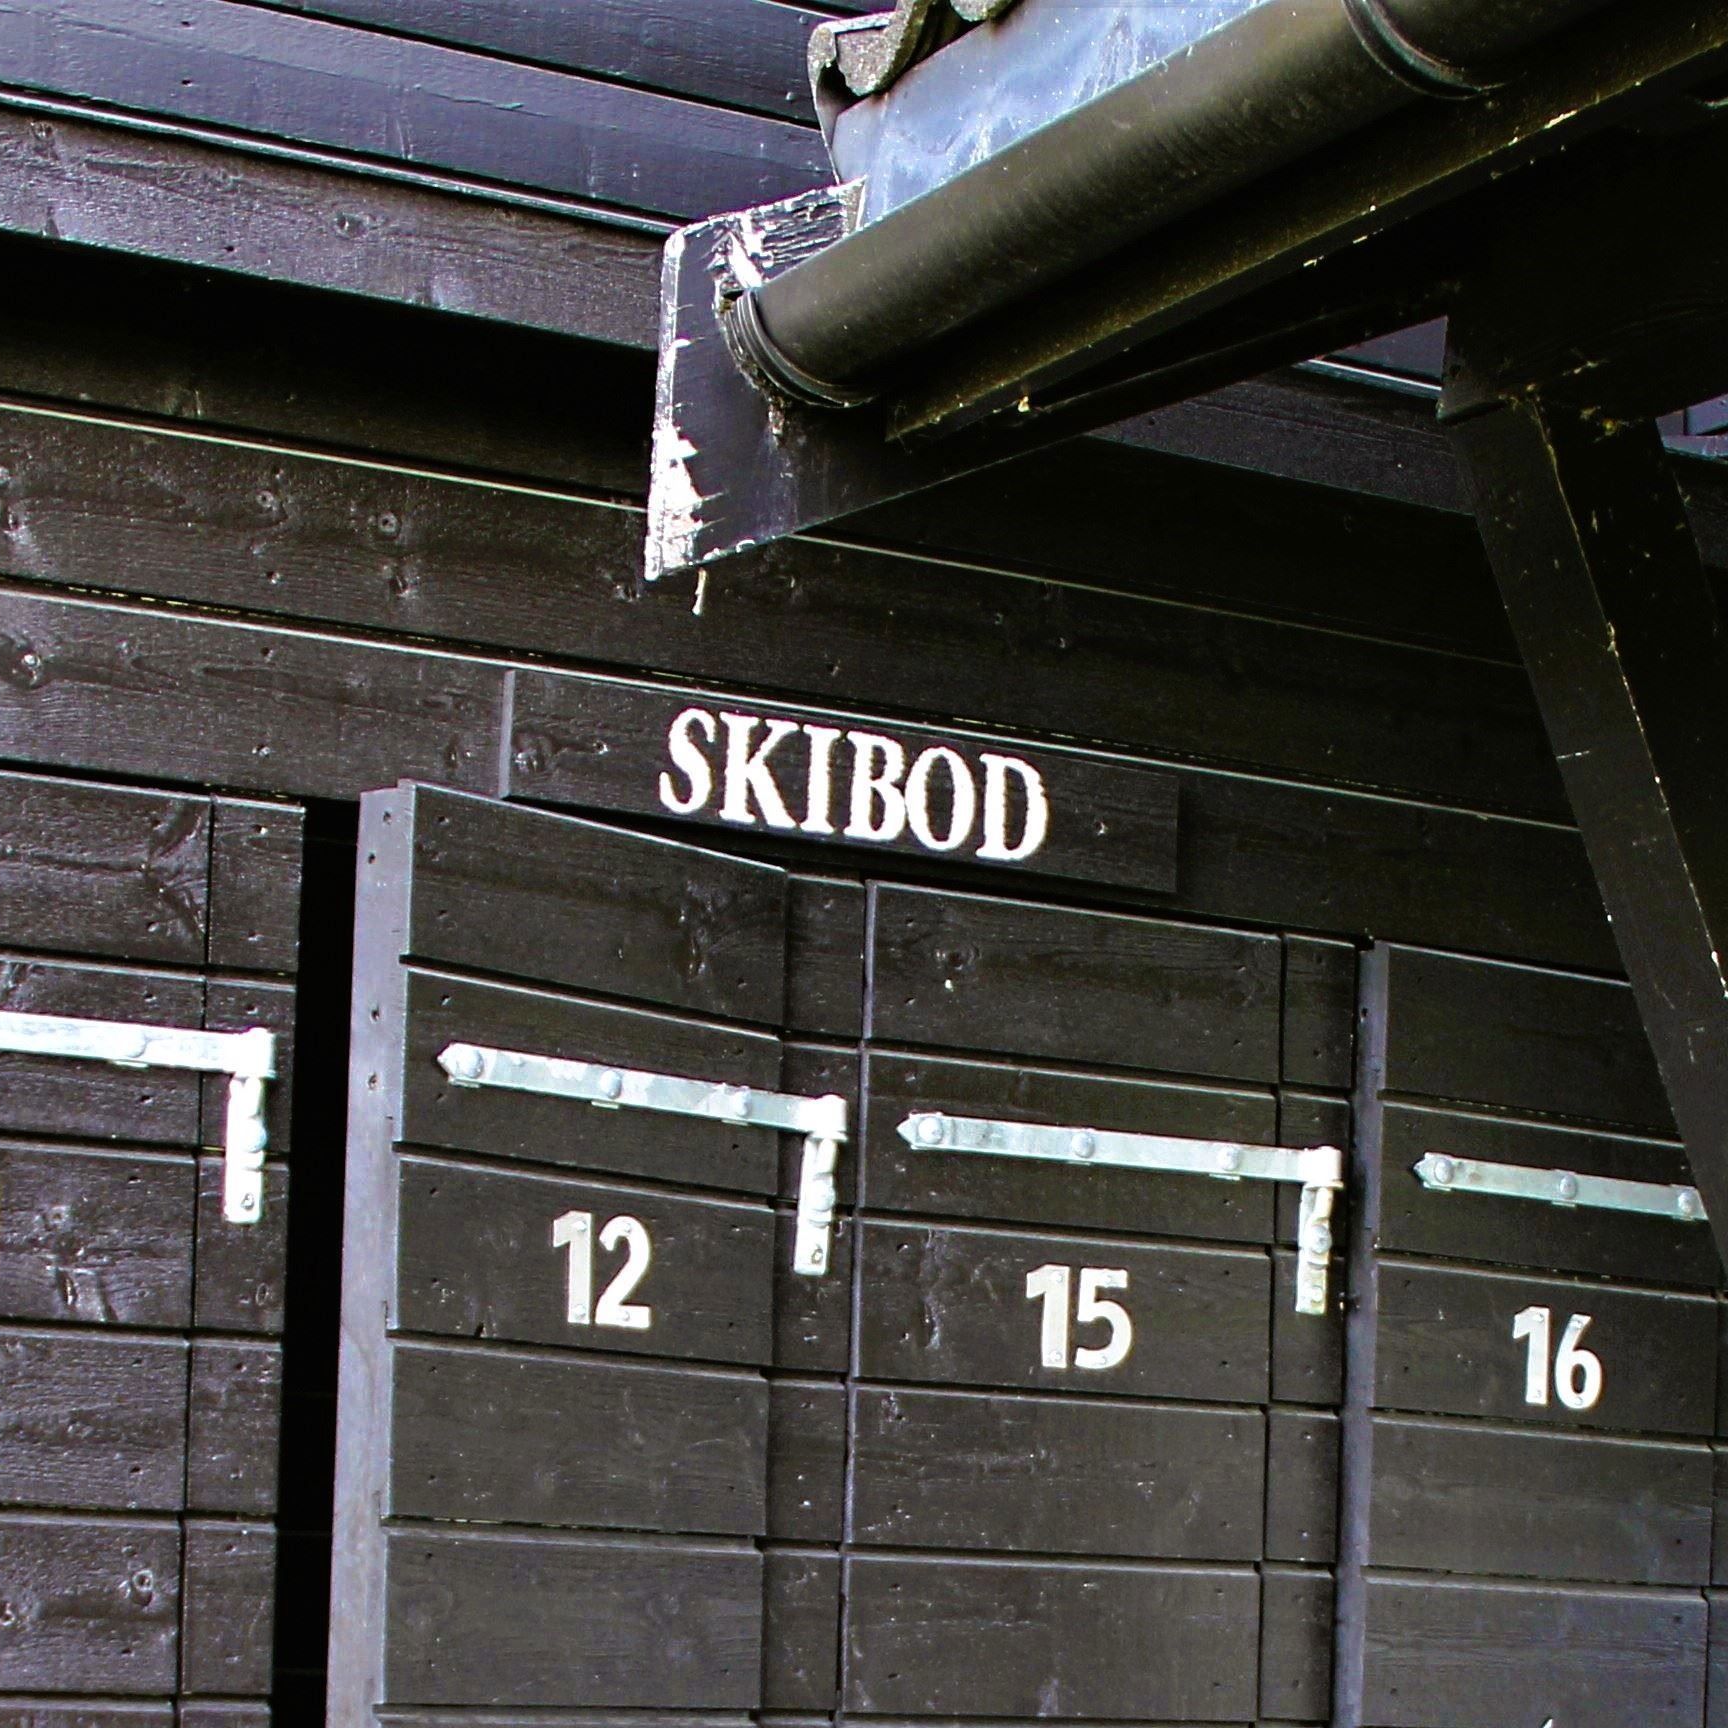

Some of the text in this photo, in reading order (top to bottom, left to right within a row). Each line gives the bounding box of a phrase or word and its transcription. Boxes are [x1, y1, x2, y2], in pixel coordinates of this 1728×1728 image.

[659, 708, 1049, 861] SKIBOD
[551, 1210, 652, 1331] 12
[1025, 1264, 1133, 1371] 15
[1511, 1305, 1602, 1411] 16
